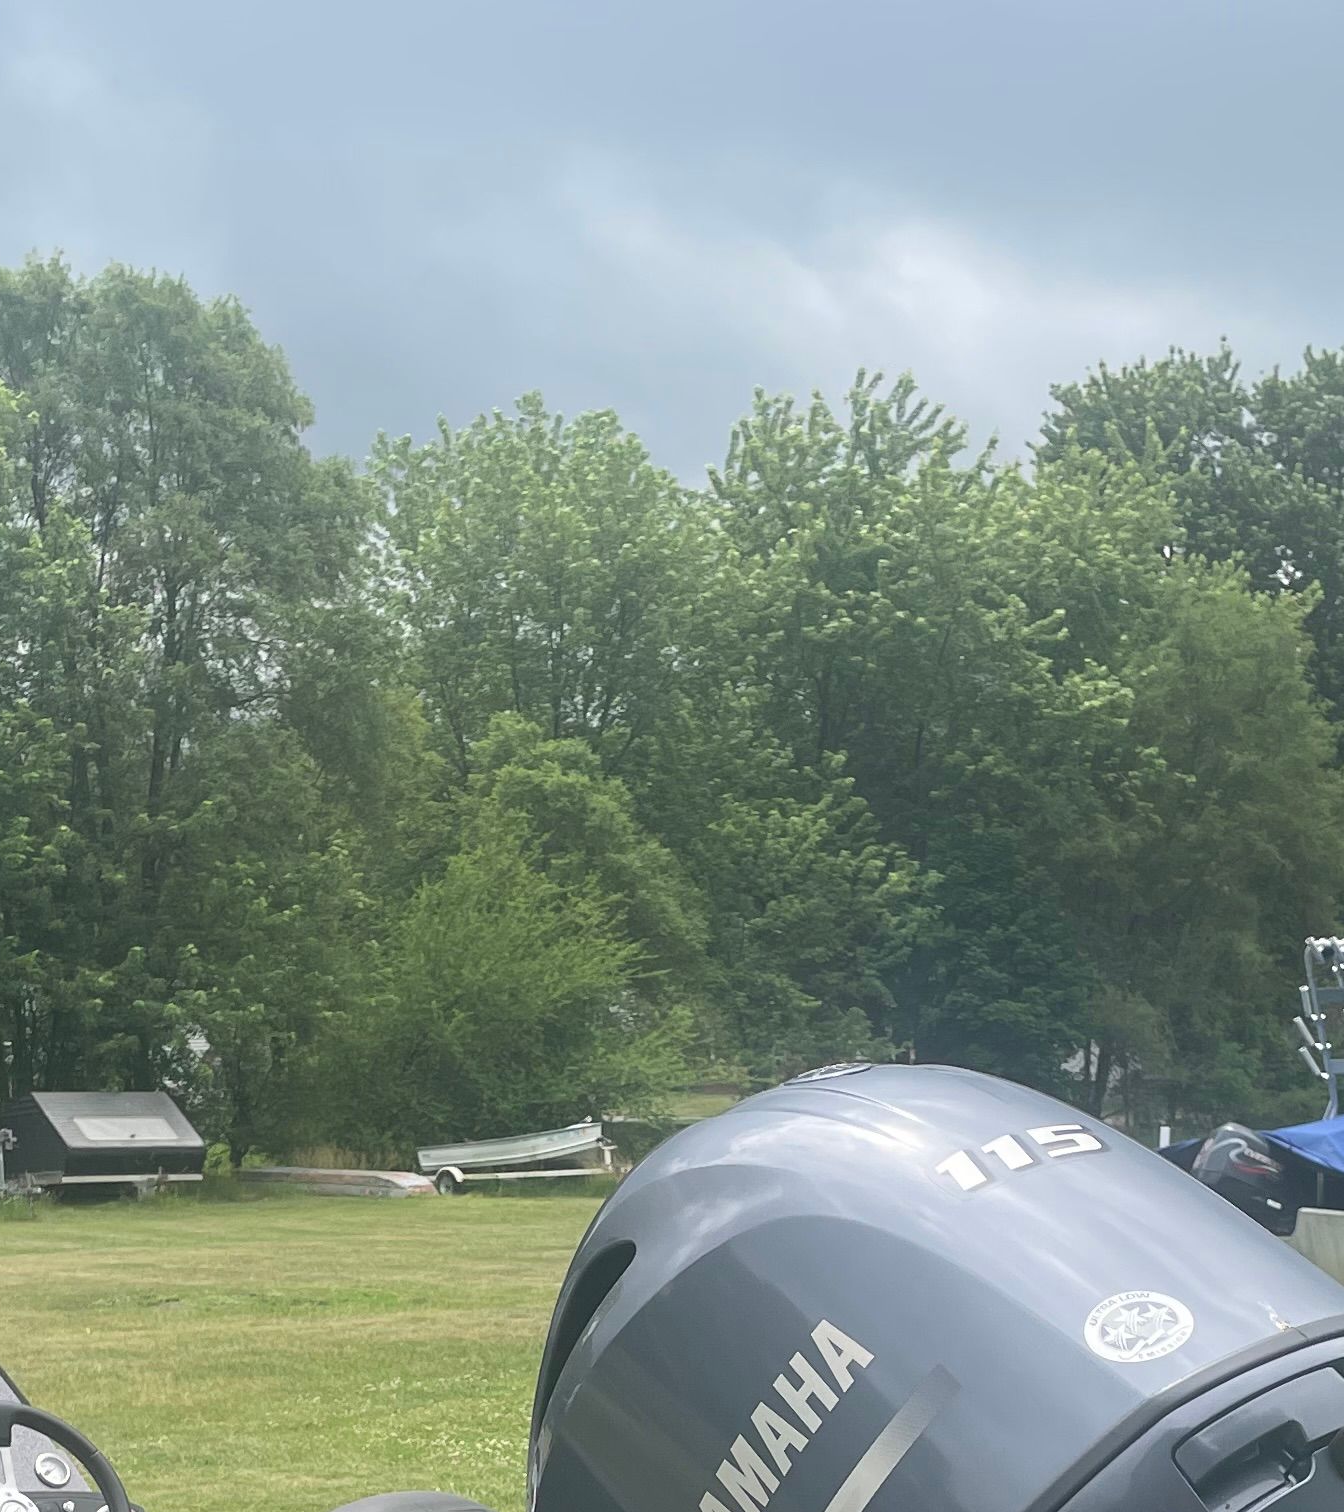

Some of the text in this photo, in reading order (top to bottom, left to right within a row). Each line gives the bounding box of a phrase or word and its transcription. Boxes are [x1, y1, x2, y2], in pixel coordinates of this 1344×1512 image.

[935, 1124, 1104, 1191] 115
[1088, 1291, 1150, 1327] ULTRA LOW
